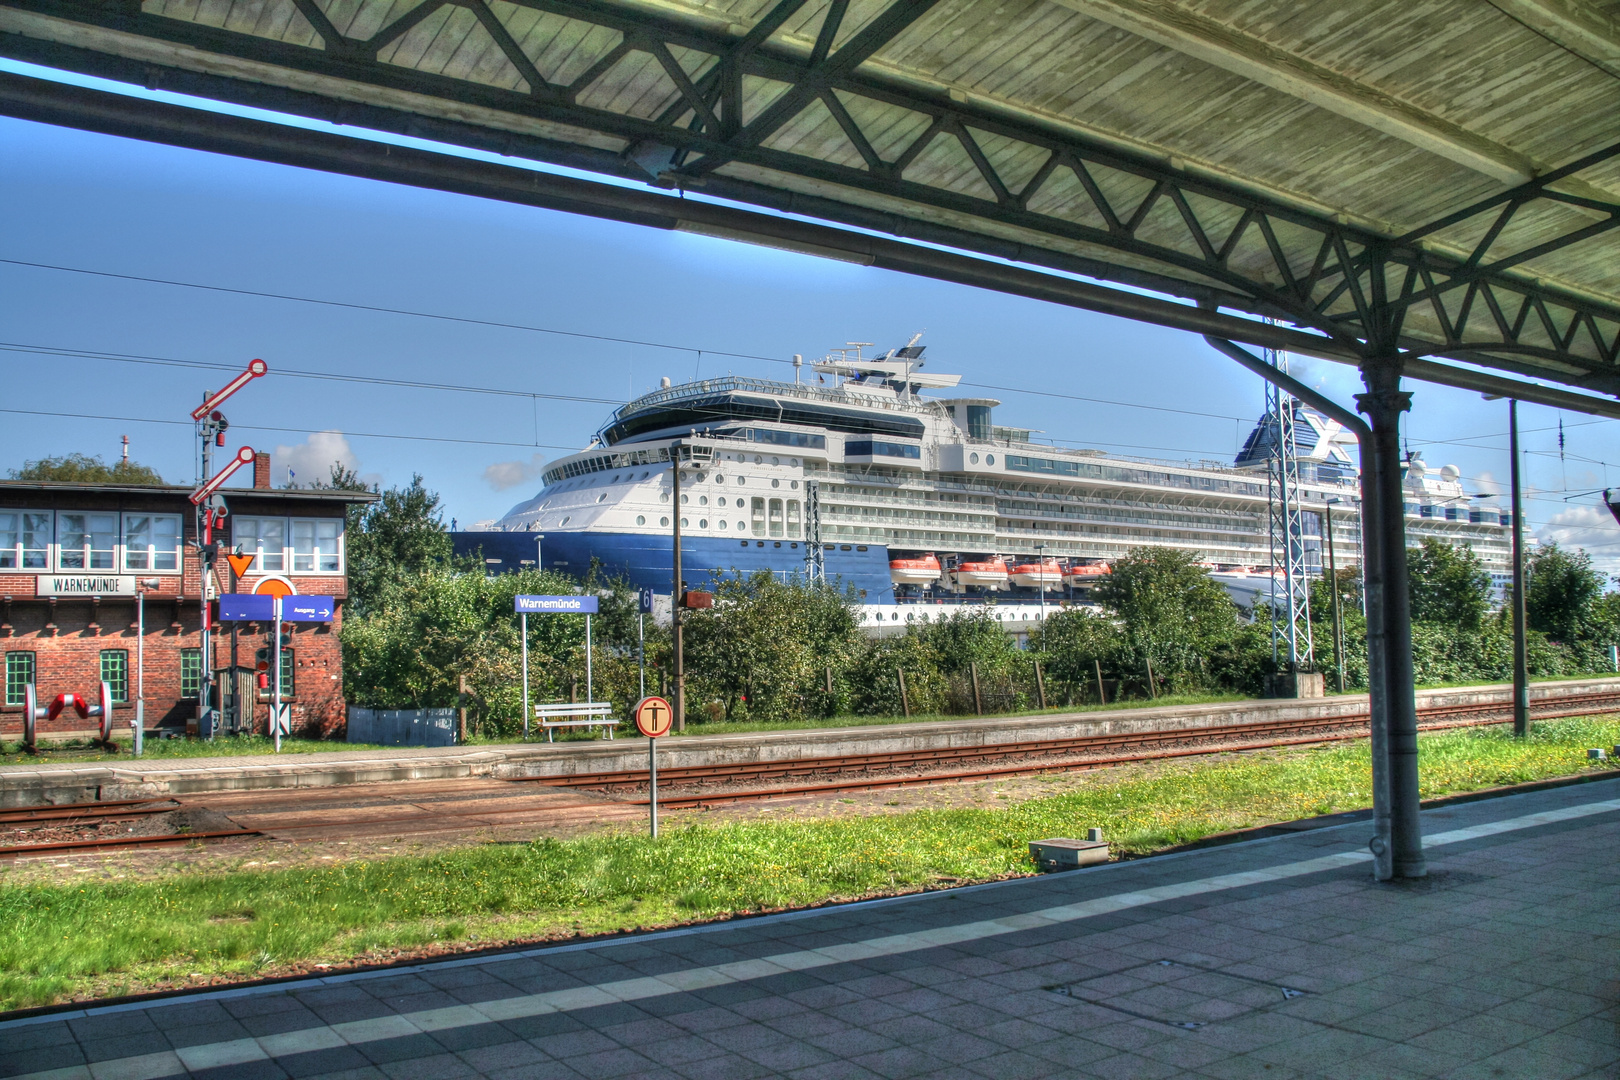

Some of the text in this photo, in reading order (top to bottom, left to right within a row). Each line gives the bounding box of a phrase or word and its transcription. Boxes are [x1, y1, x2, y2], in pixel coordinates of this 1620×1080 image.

[53, 577, 120, 592] WARNEMÜNDE
[206, 588, 213, 598] F
[519, 598, 581, 609] Warnemünde
[643, 590, 650, 608] 6
[293, 607, 316, 615] Ausgang
